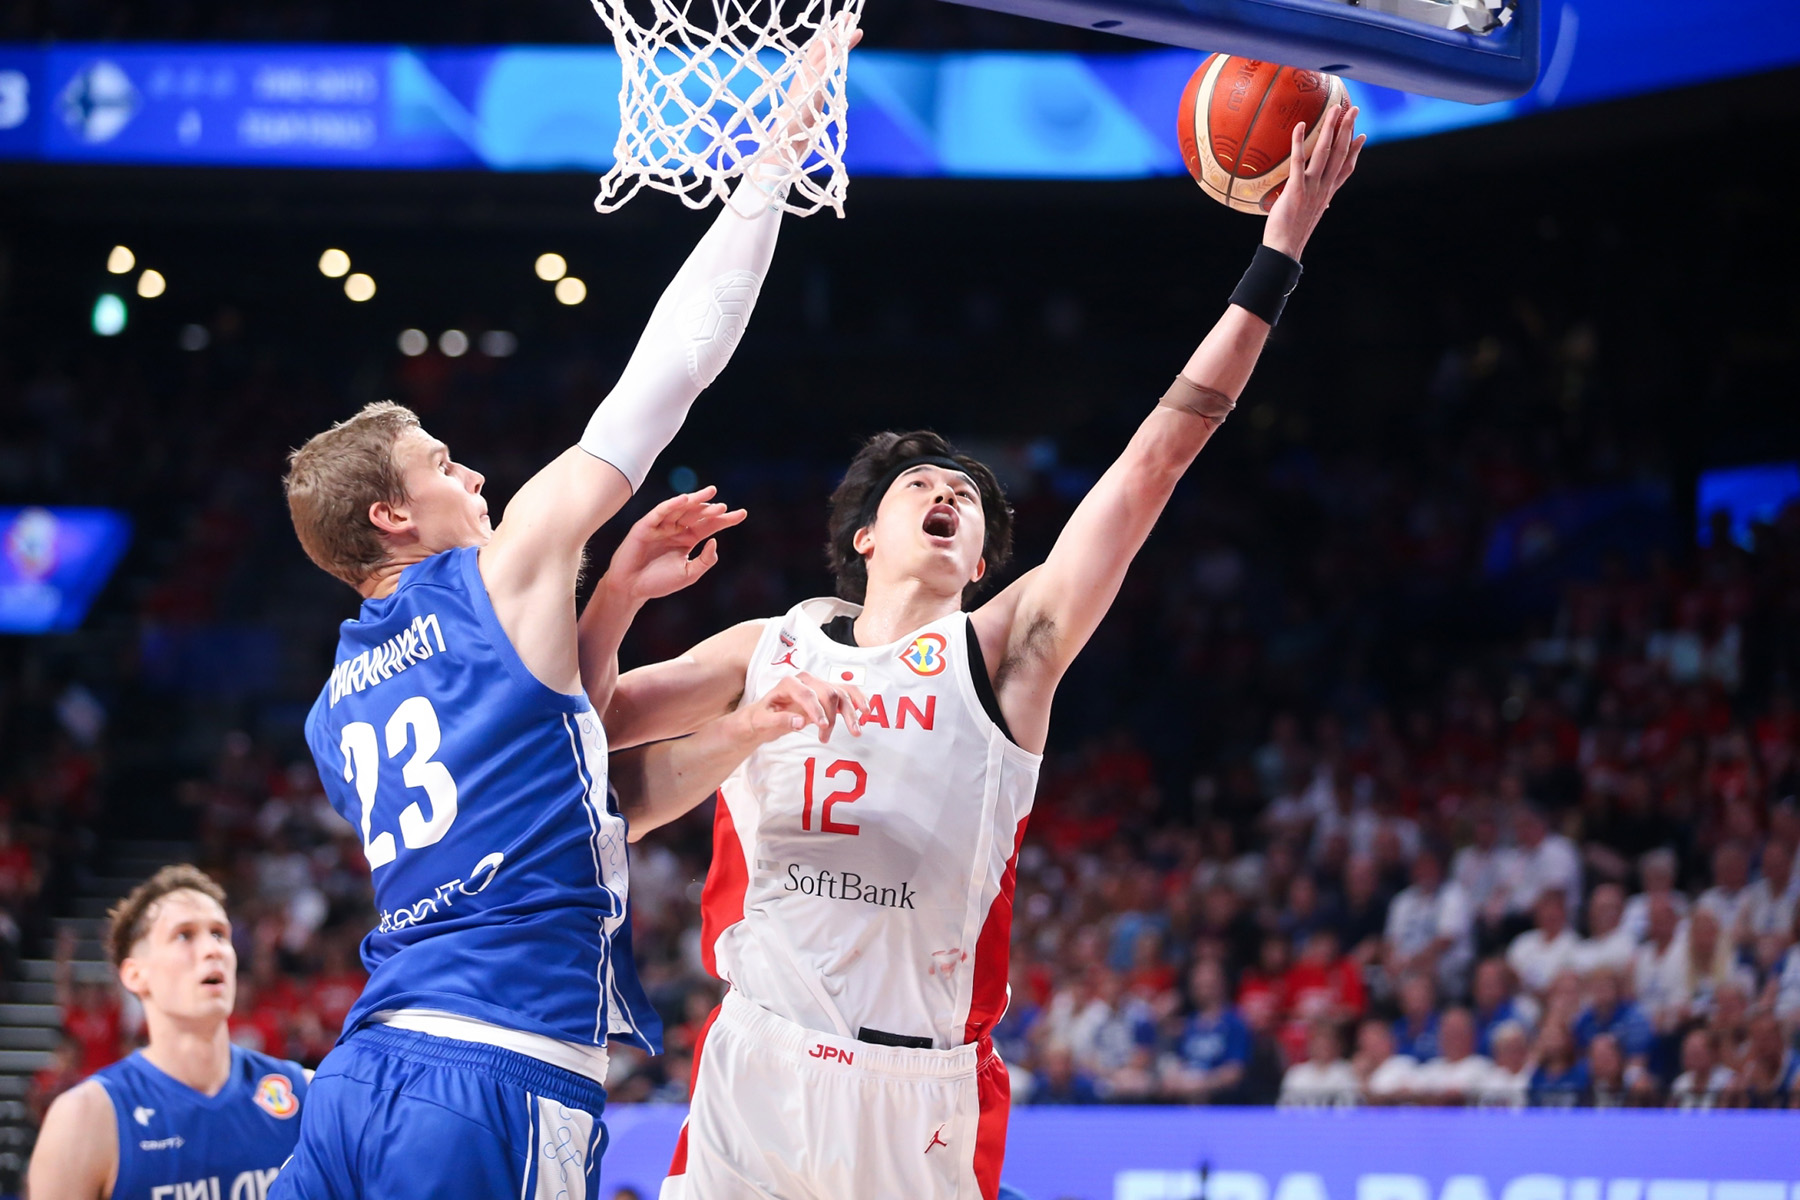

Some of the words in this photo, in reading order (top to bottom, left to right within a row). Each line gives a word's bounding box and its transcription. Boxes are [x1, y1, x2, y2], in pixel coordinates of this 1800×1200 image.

[1228, 59, 1261, 111] molte
[340, 696, 458, 872] 23
[801, 756, 868, 836] 12
[784, 863, 916, 909] SoftBank
[808, 1043, 854, 1065] JPN
